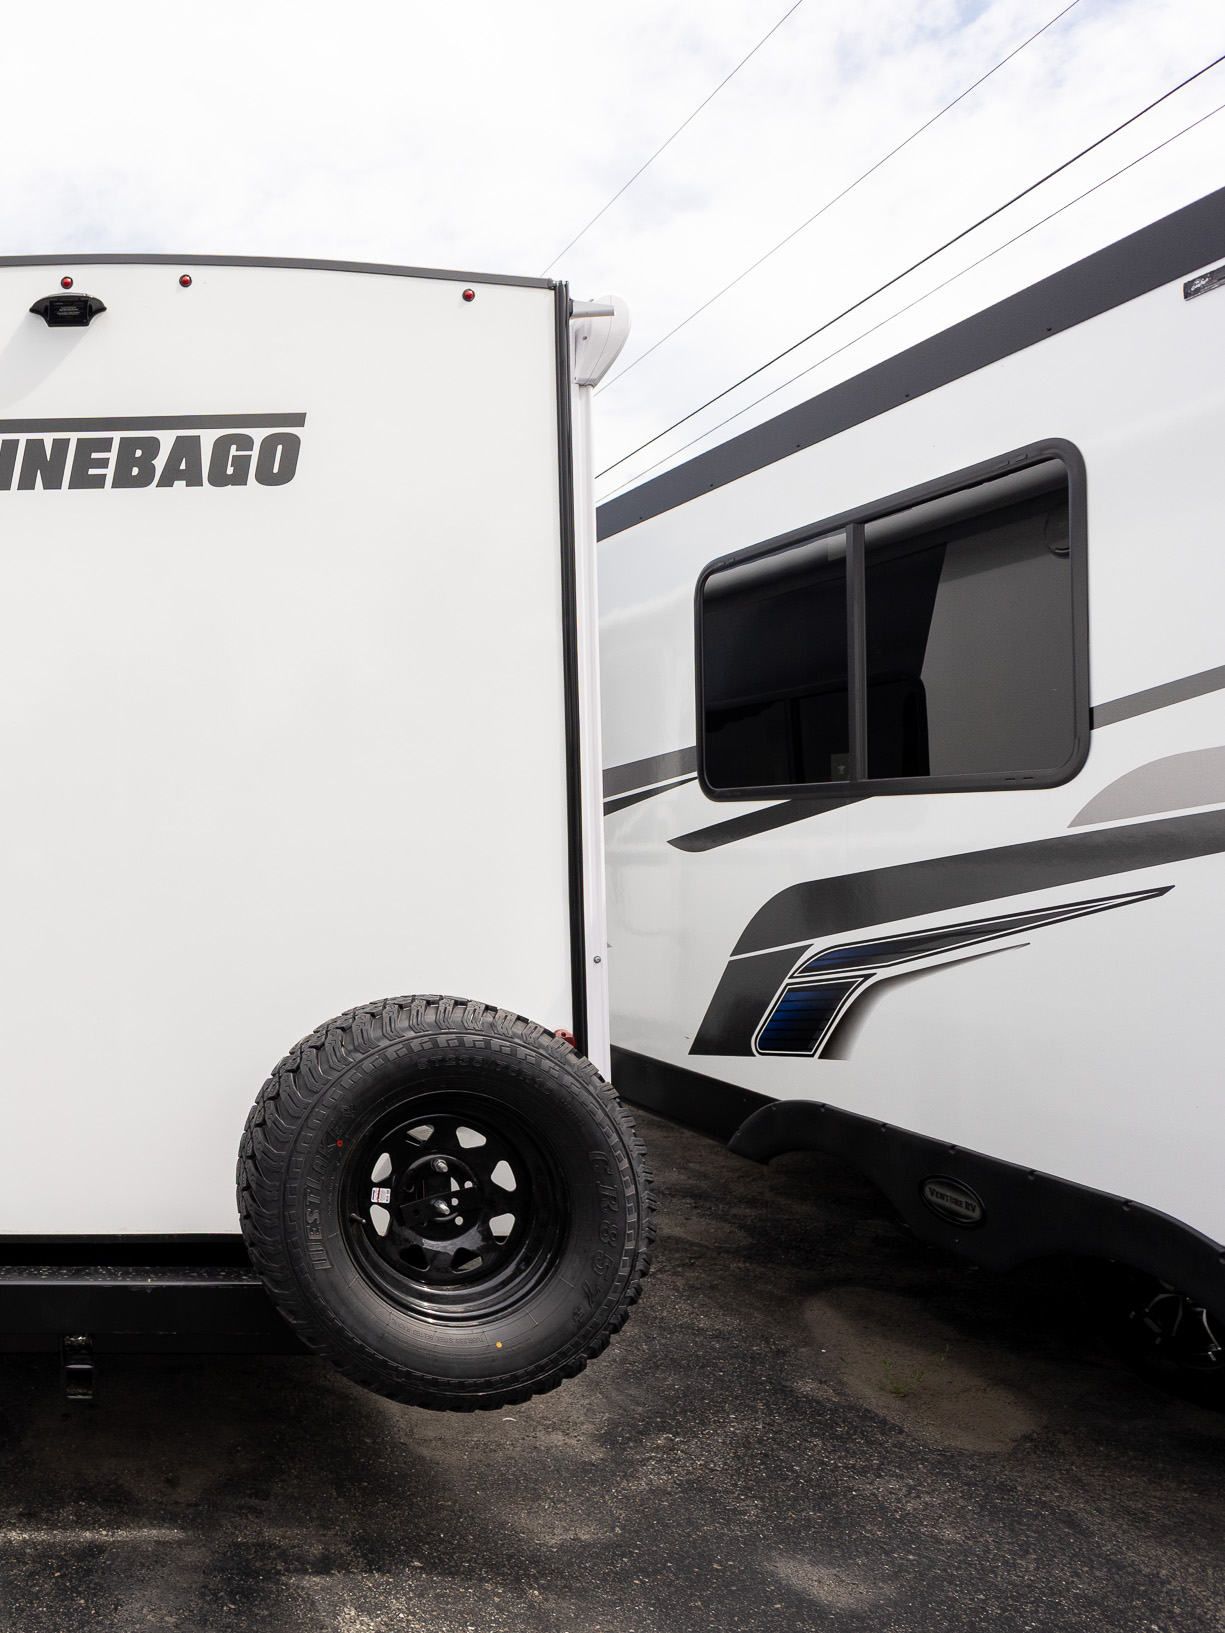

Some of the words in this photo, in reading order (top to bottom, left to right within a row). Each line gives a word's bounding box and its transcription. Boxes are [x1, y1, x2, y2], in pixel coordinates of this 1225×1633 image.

[306, 1120, 344, 1270] WESTLAKE
[928, 1186, 964, 1208] VENTURE
[964, 1200, 977, 1213] RV
